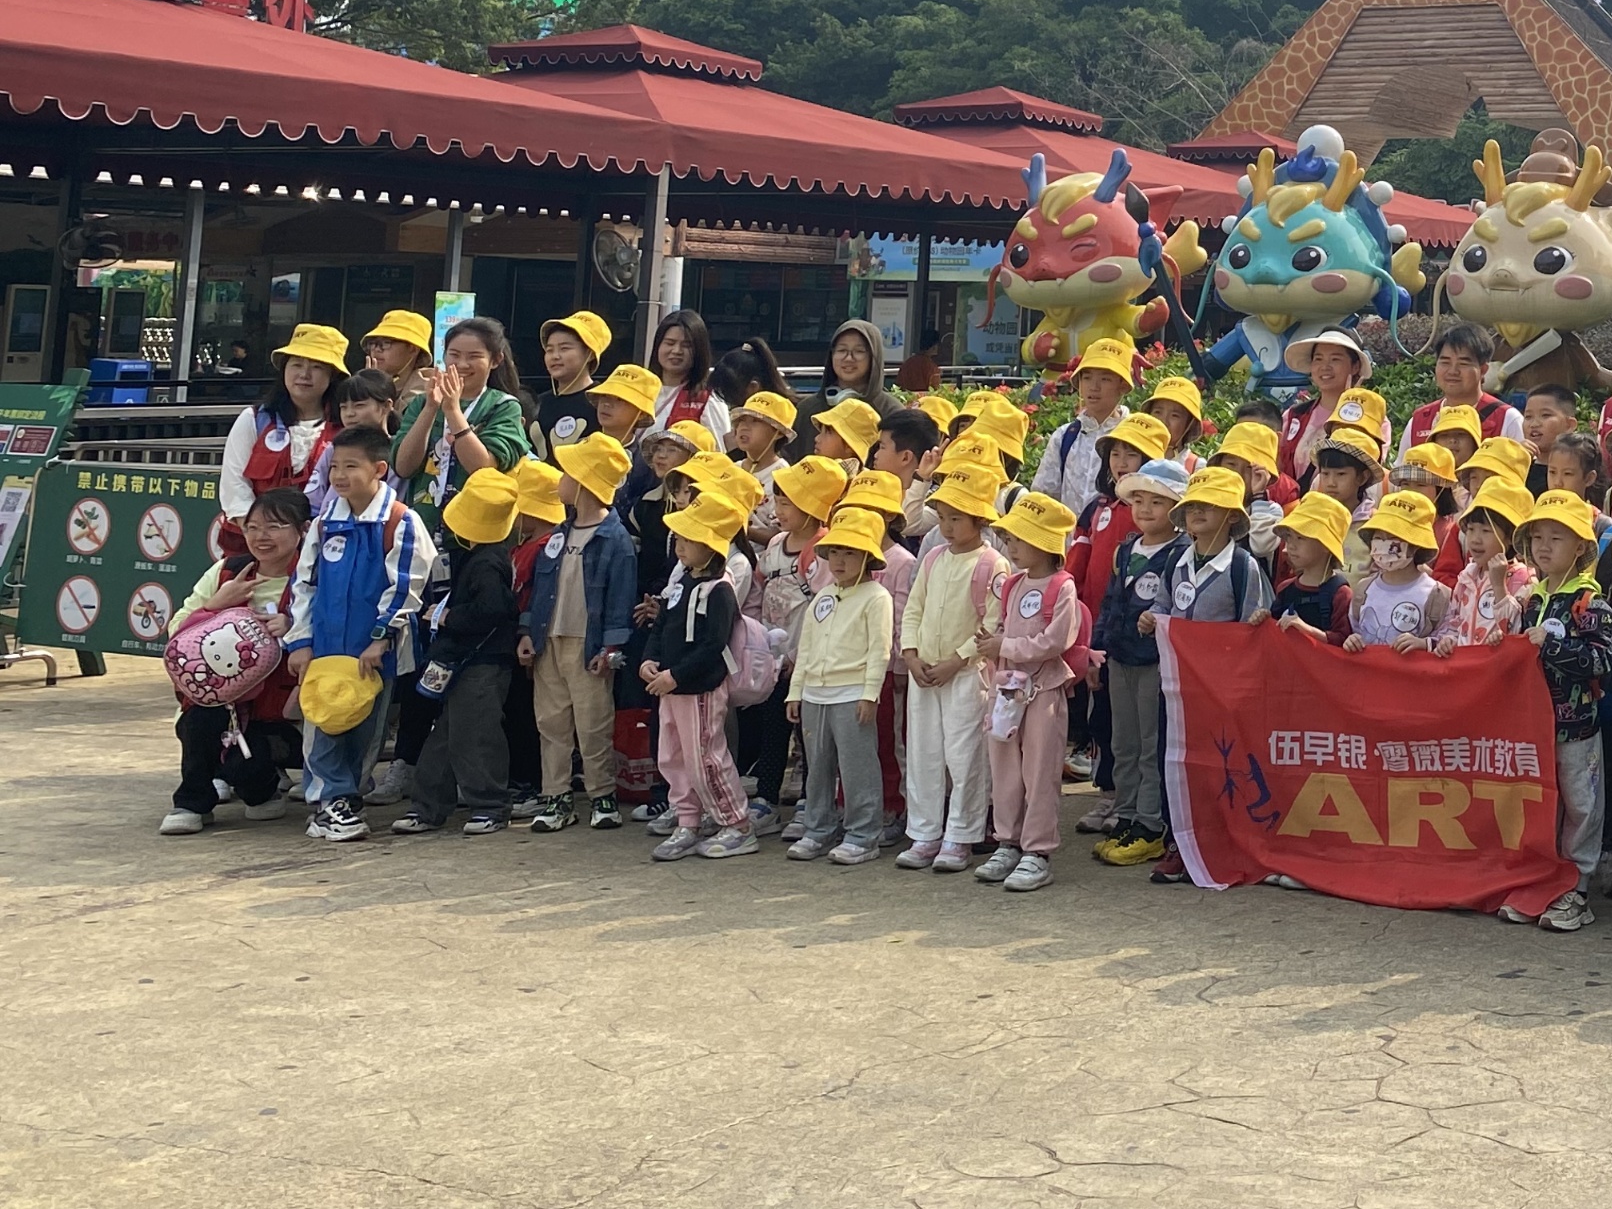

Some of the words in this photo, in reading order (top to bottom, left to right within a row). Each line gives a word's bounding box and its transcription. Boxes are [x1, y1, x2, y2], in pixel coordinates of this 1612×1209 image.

[1100, 345, 1123, 356] ART
[614, 371, 639, 381] ART
[1343, 394, 1367, 405] ART
[1127, 418, 1152, 430] ART
[77, 472, 216, 499] 禁止携带以下物品
[1021, 502, 1046, 515] ART
[1388, 499, 1416, 513] ART
[1268, 730, 1542, 778] 伍早银·廖薇美术教育
[1277, 772, 1544, 851] ART
